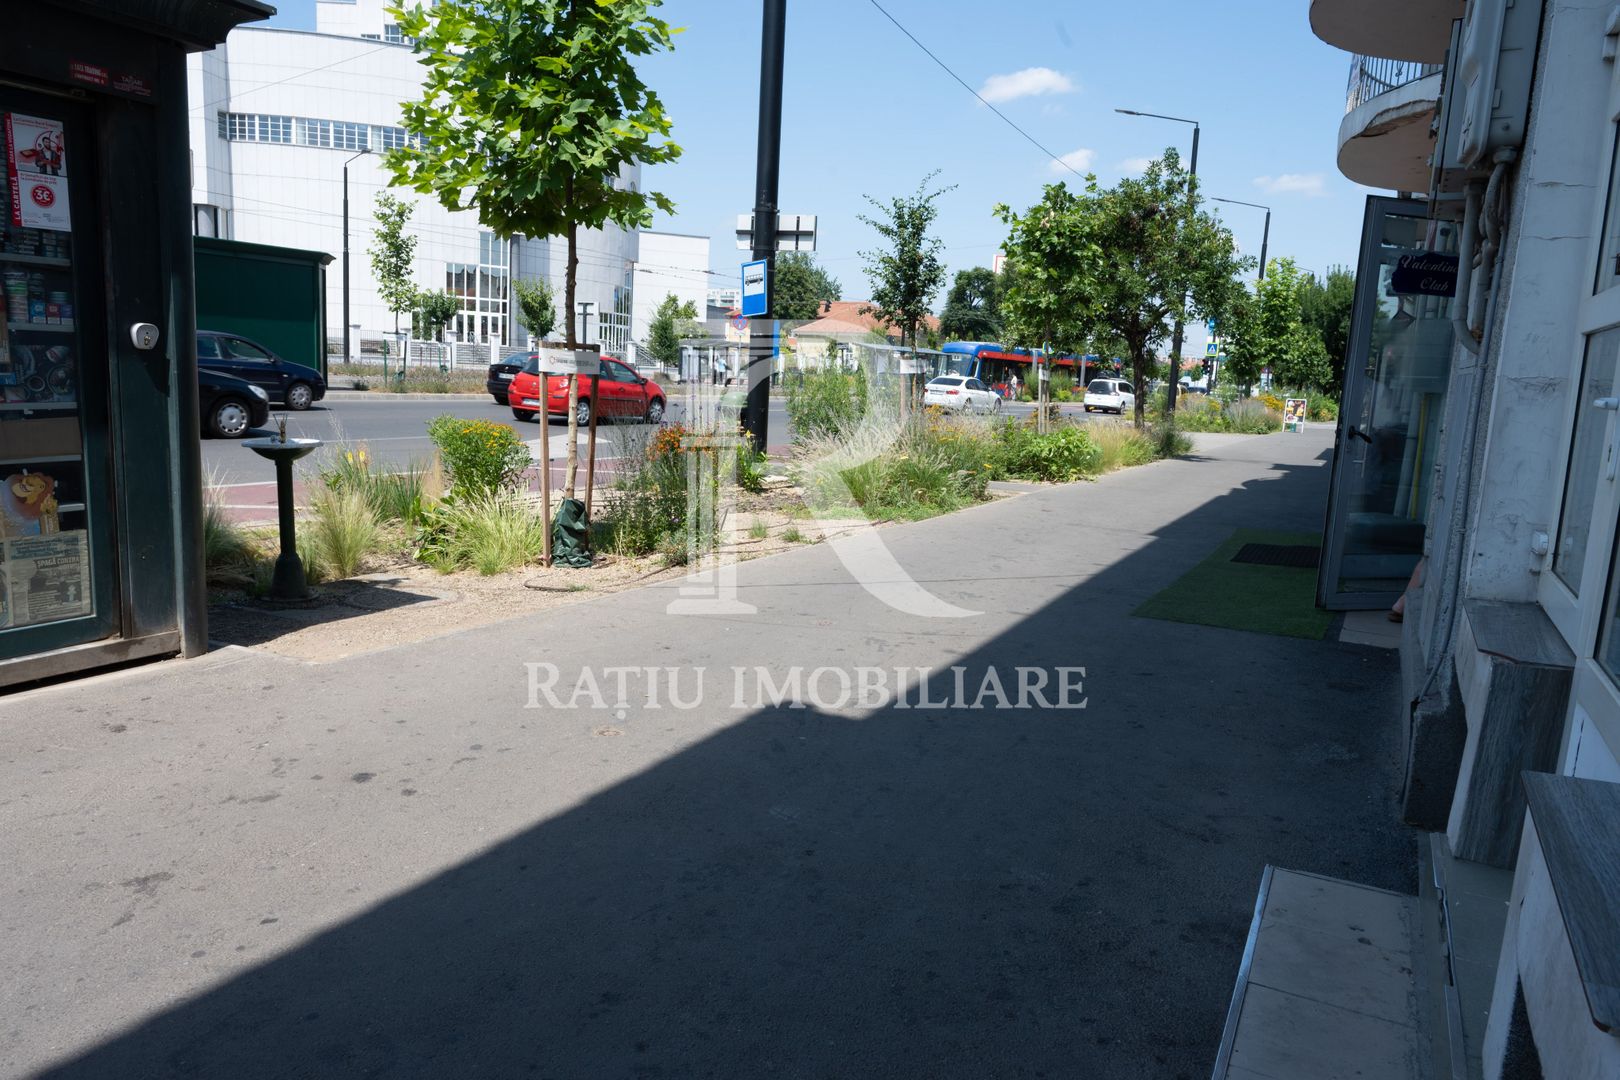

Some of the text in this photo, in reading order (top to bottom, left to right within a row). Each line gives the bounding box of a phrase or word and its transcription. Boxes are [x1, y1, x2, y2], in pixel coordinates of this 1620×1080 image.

[35, 189, 50, 201] 3€
[14, 211, 21, 220] LA
[1420, 277, 1449, 292] Club
